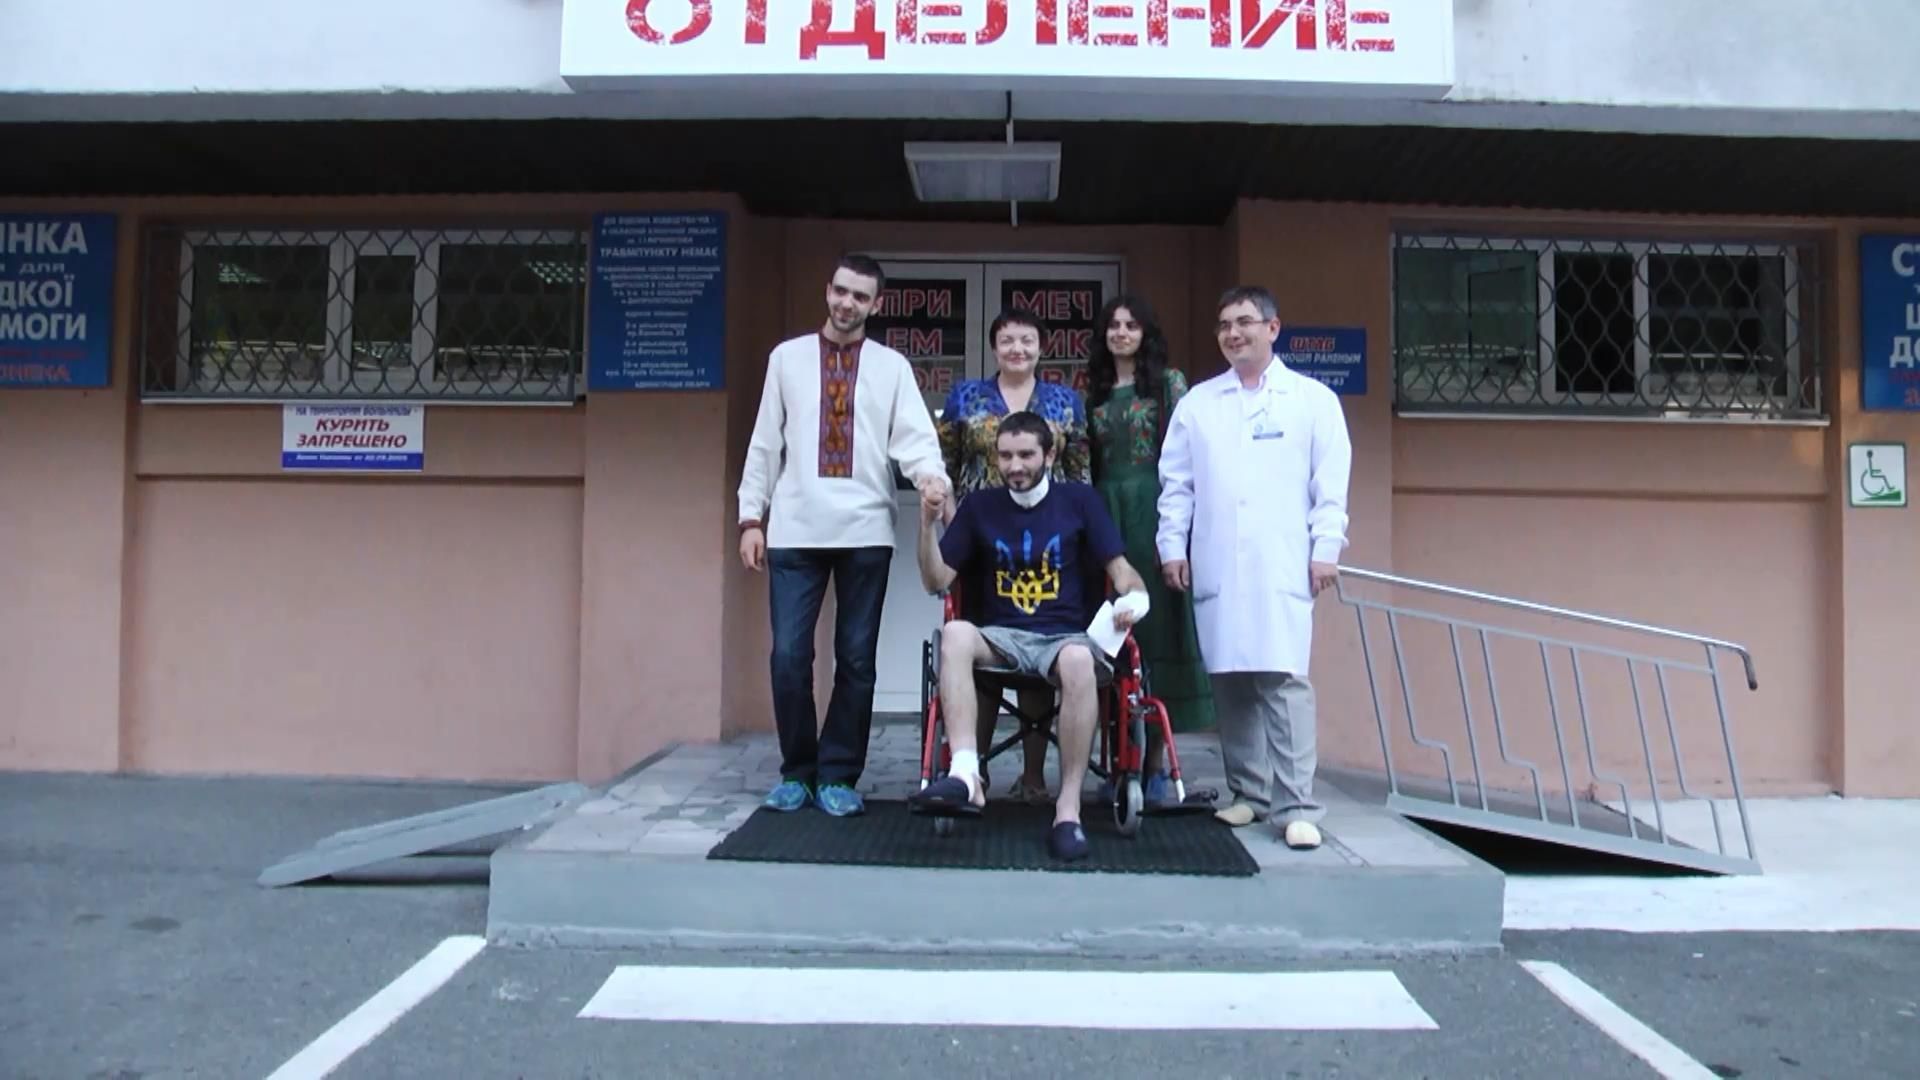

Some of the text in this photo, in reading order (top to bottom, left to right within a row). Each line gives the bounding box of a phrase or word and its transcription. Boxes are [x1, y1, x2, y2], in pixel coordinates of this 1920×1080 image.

[625, 0, 1396, 60] ОТДЕЛЕНИЕ
[0, 222, 88, 254] НКА
[880, 288, 951, 317] ПРИ
[1012, 290, 1093, 320] МЕЧ
[886, 327, 943, 356] ЕМ
[1040, 328, 1092, 358] ИК
[915, 367, 952, 394] ОЕ
[1041, 367, 1091, 396] ВА
[316, 419, 390, 432] КУРИТЬ
[297, 434, 408, 448] ЗАПРЕЩЕНО
